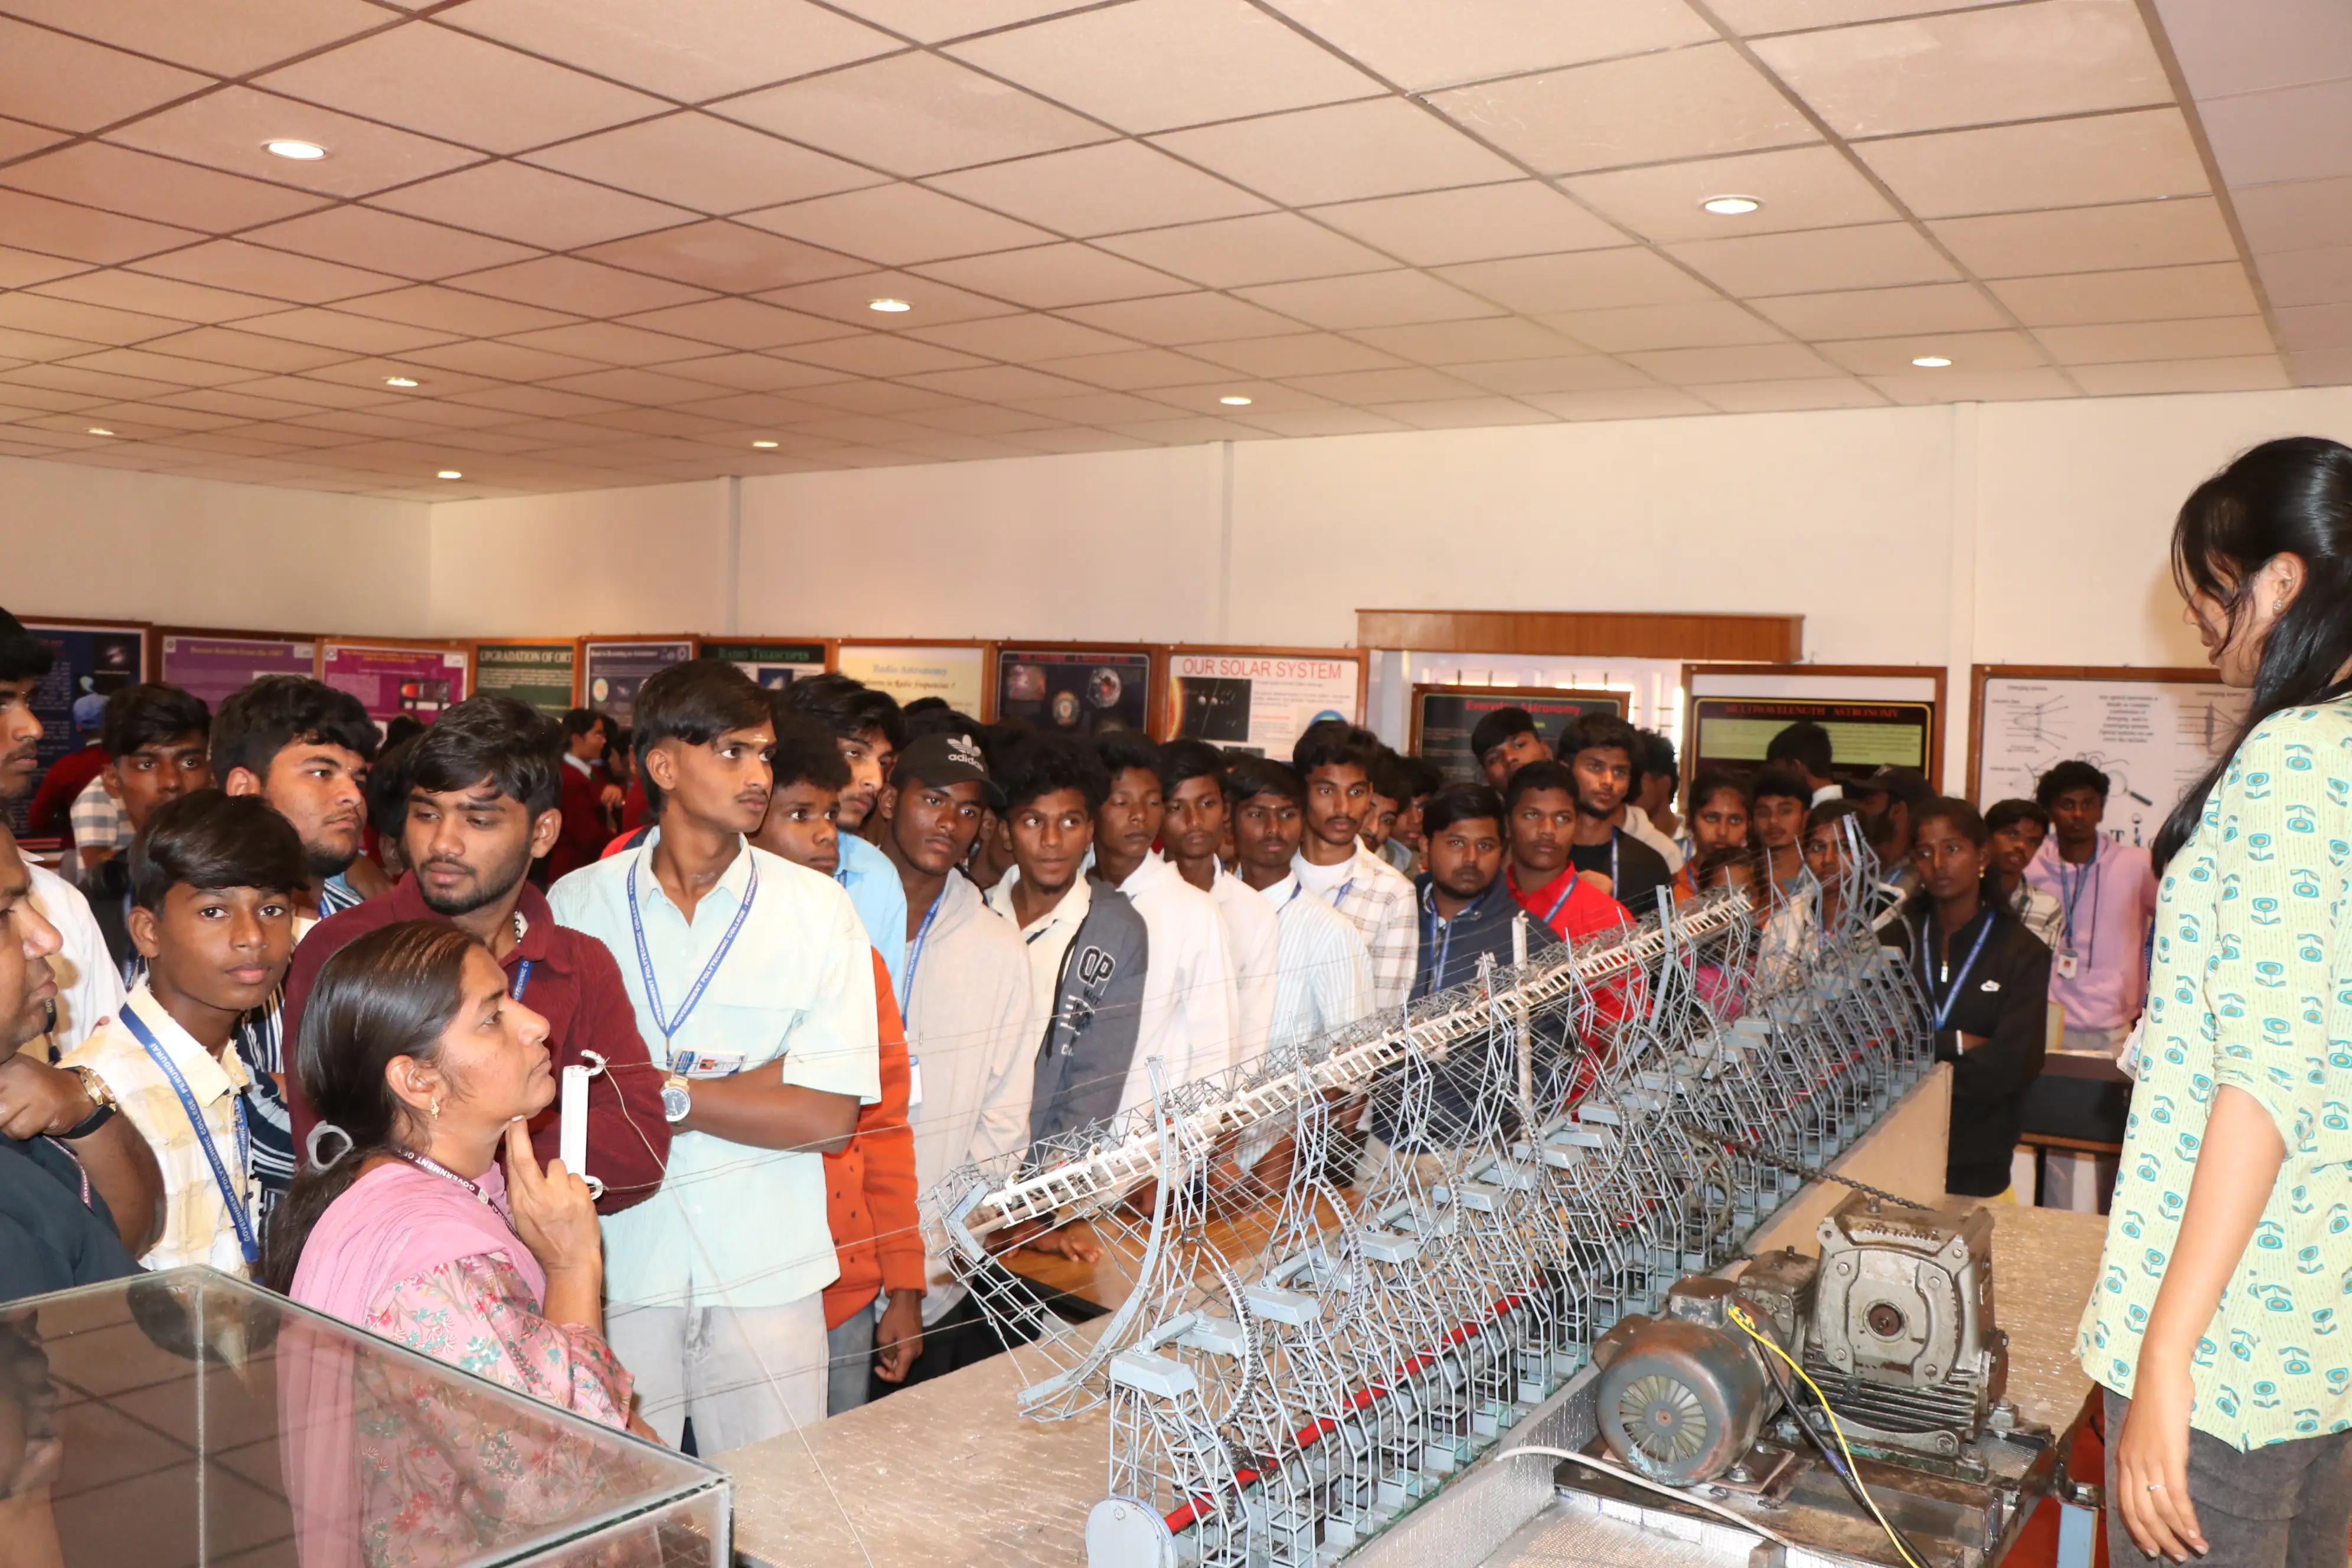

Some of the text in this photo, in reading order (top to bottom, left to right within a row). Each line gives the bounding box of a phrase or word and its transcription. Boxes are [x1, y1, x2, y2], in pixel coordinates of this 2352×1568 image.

[479, 650, 574, 663] UPGRADATION OF ORT
[1182, 658, 1342, 680] OUR SOLAR SYSTEM
[948, 754, 984, 772] adidas
[637, 931, 652, 979] POLYTECHNIC
[673, 982, 703, 1026] GOVERNMENT
[700, 938, 729, 983] POLYTECHNIC
[727, 909, 747, 939] COLLEGE
[150, 1043, 188, 1093] PERUNDURAI
[187, 1098, 206, 1135] COLLEGE
[204, 1135, 231, 1191] POLYTECHNIC
[415, 1156, 475, 1191] GOVERNMENT
[227, 1190, 251, 1242] GOVERNMENT
